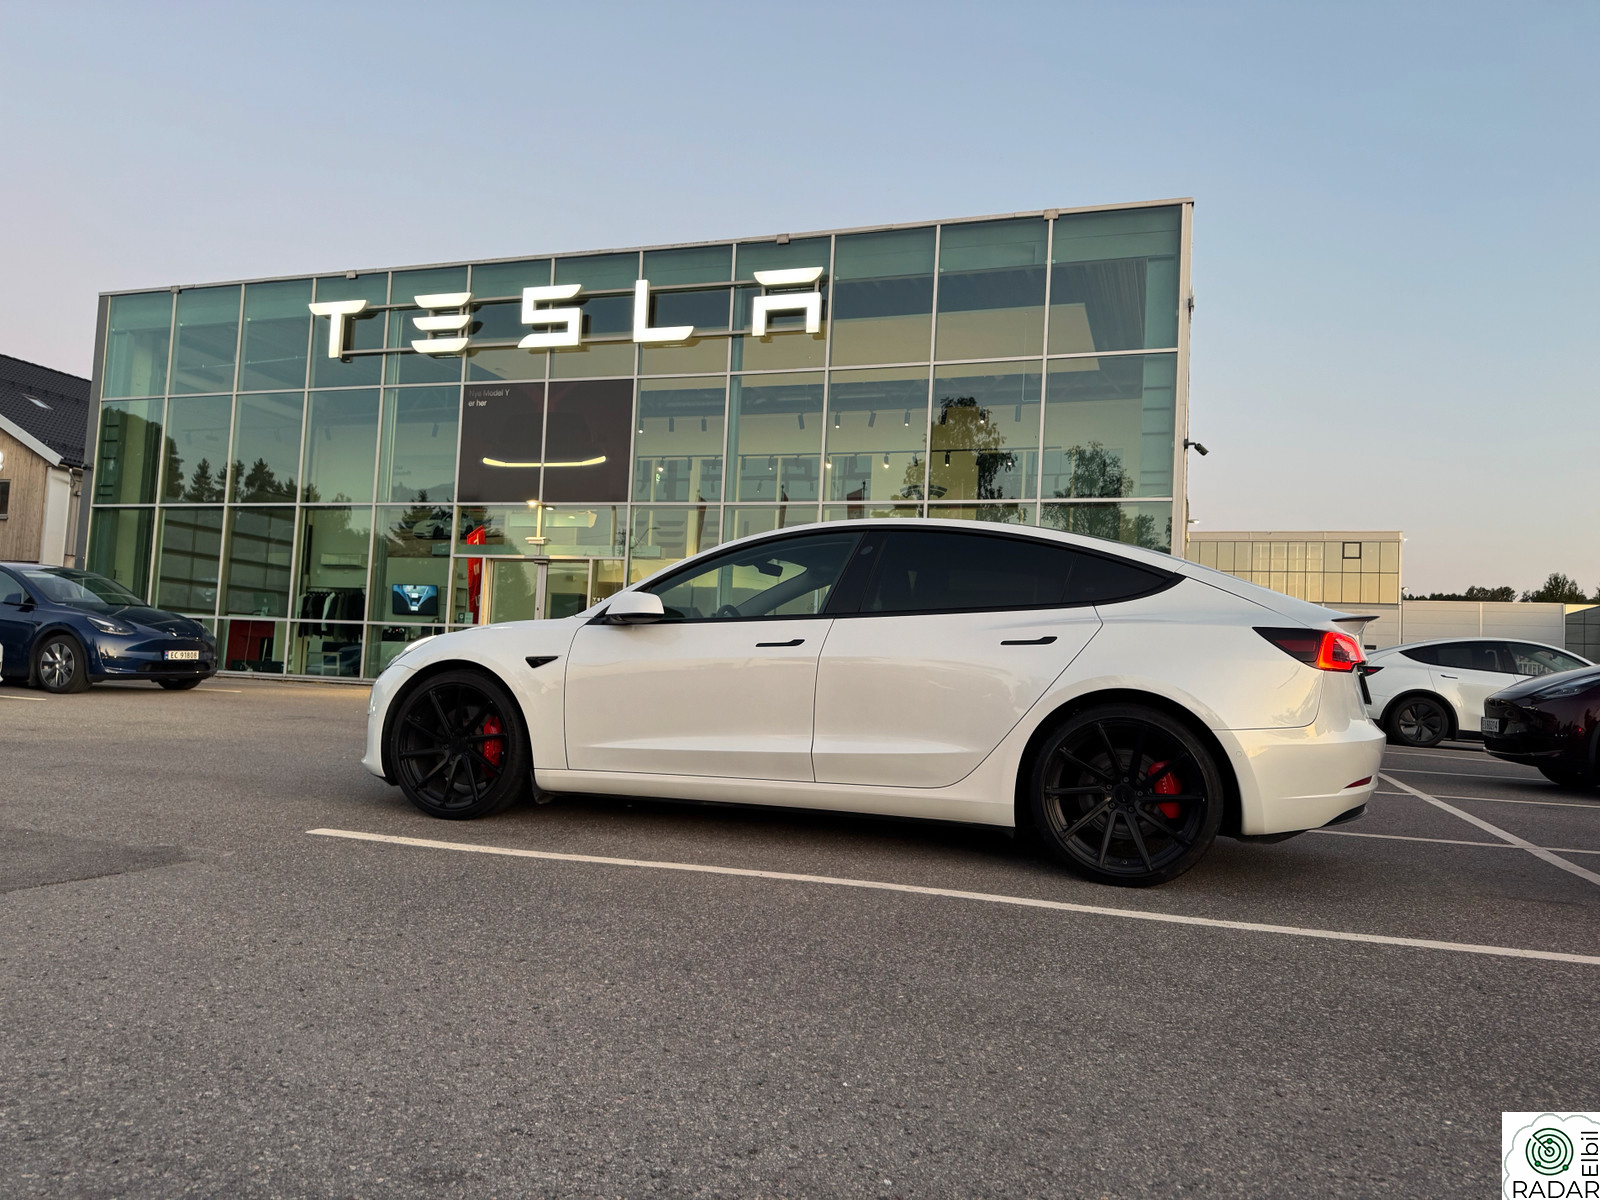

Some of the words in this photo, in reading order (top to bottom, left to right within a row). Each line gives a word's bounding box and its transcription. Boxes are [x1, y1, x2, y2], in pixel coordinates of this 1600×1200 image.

[308, 266, 824, 359] TESLA
[483, 389, 504, 397] Model
[505, 389, 510, 397] Y
[476, 399, 487, 407] her
[170, 651, 178, 659] EC
